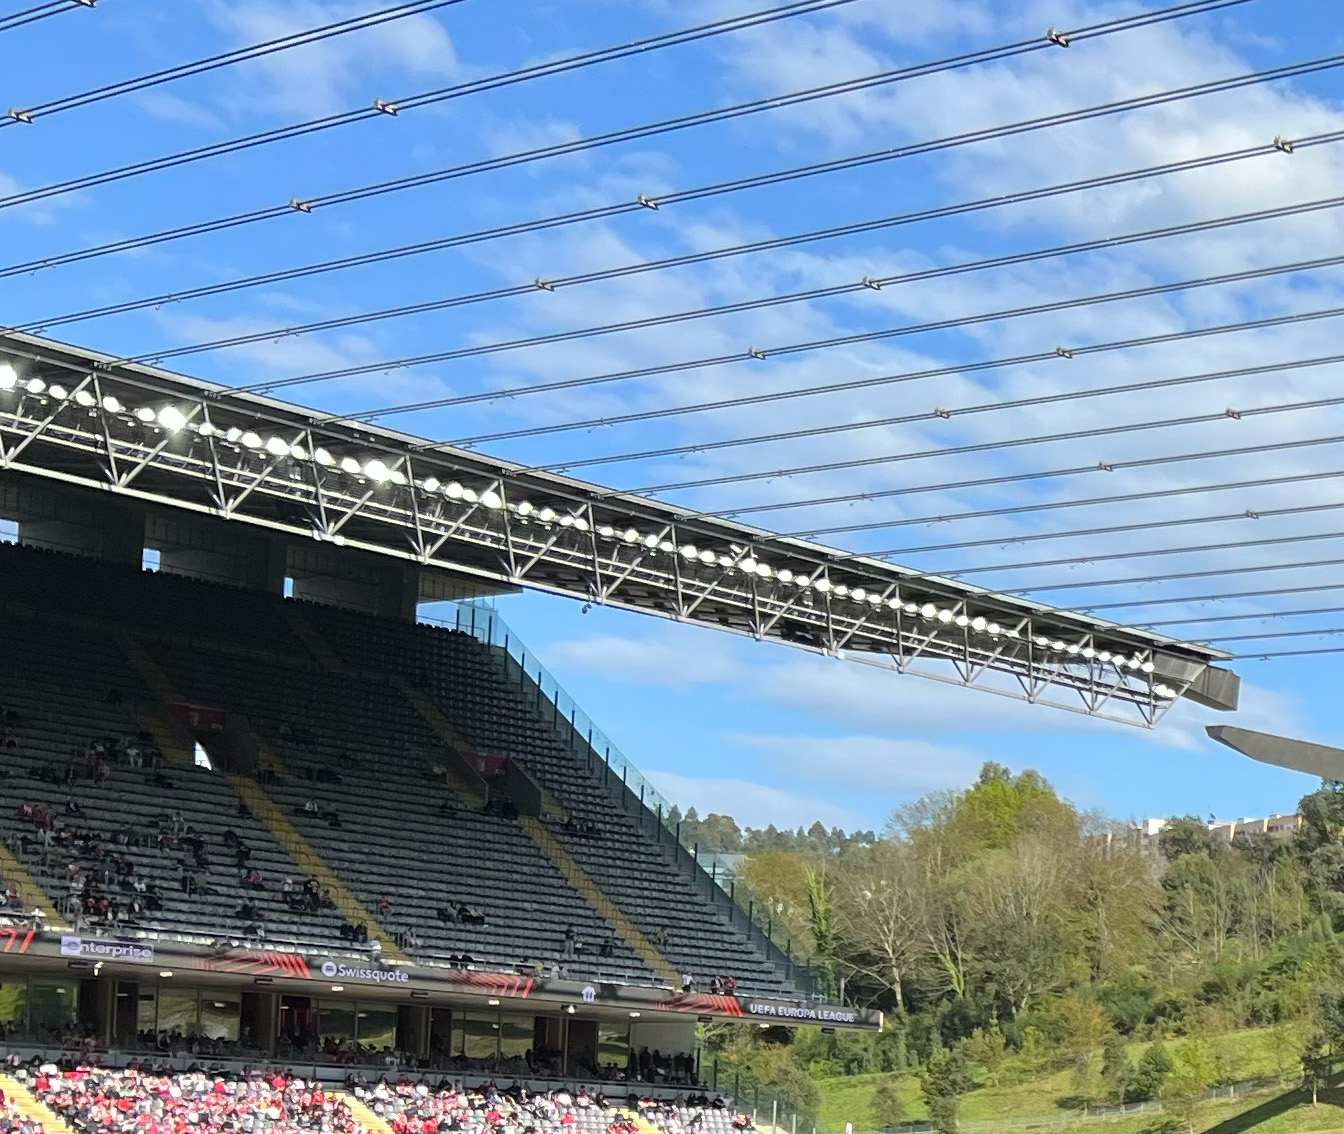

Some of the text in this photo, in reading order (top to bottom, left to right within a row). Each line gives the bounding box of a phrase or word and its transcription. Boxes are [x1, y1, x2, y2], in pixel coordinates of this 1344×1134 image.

[338, 964, 409, 982] Swissquote
[750, 1004, 855, 1022] UEFA EUROPA LEAGUE
